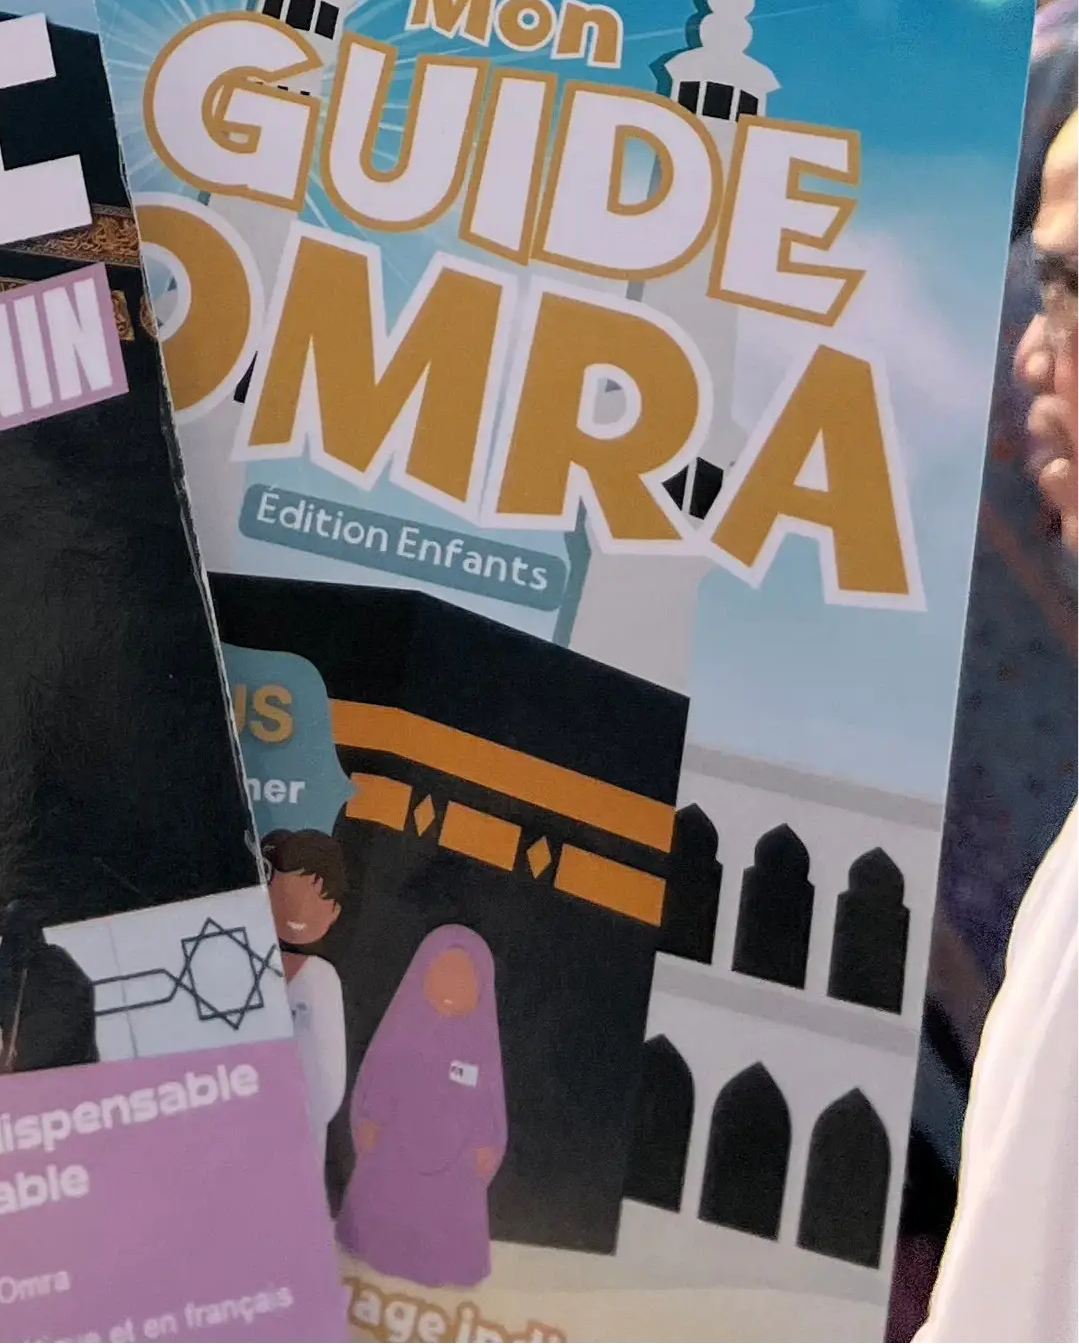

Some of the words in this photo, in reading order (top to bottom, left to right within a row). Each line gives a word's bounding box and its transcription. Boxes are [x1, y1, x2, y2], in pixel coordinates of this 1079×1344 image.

[142, 10, 866, 327] GUIDE
[256, 484, 389, 553] Édition
[396, 525, 549, 591] Enfants
[142, 1312, 179, 1339] en
[183, 1285, 295, 1330] français
